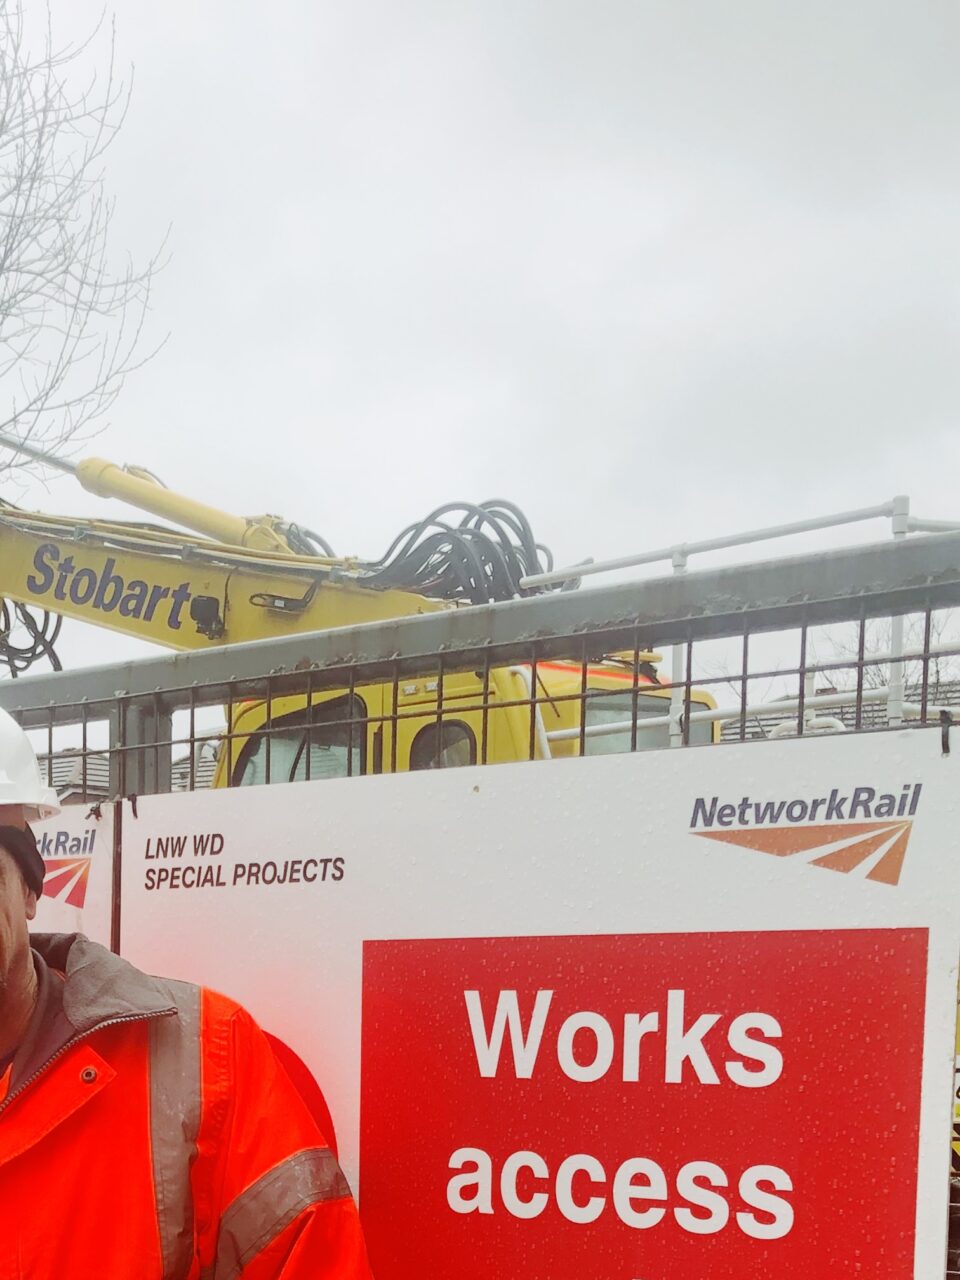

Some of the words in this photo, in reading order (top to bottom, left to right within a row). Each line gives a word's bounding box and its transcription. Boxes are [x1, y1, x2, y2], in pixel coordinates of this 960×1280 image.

[26, 543, 192, 630] Stobart
[689, 783, 923, 829] NetworkRail
[144, 864, 227, 890] SPECIAL
[232, 857, 346, 886] PROJECTS
[145, 835, 187, 860] LNW
[192, 833, 224, 857] WD
[464, 989, 784, 1088] Works
[445, 1146, 794, 1239] access
